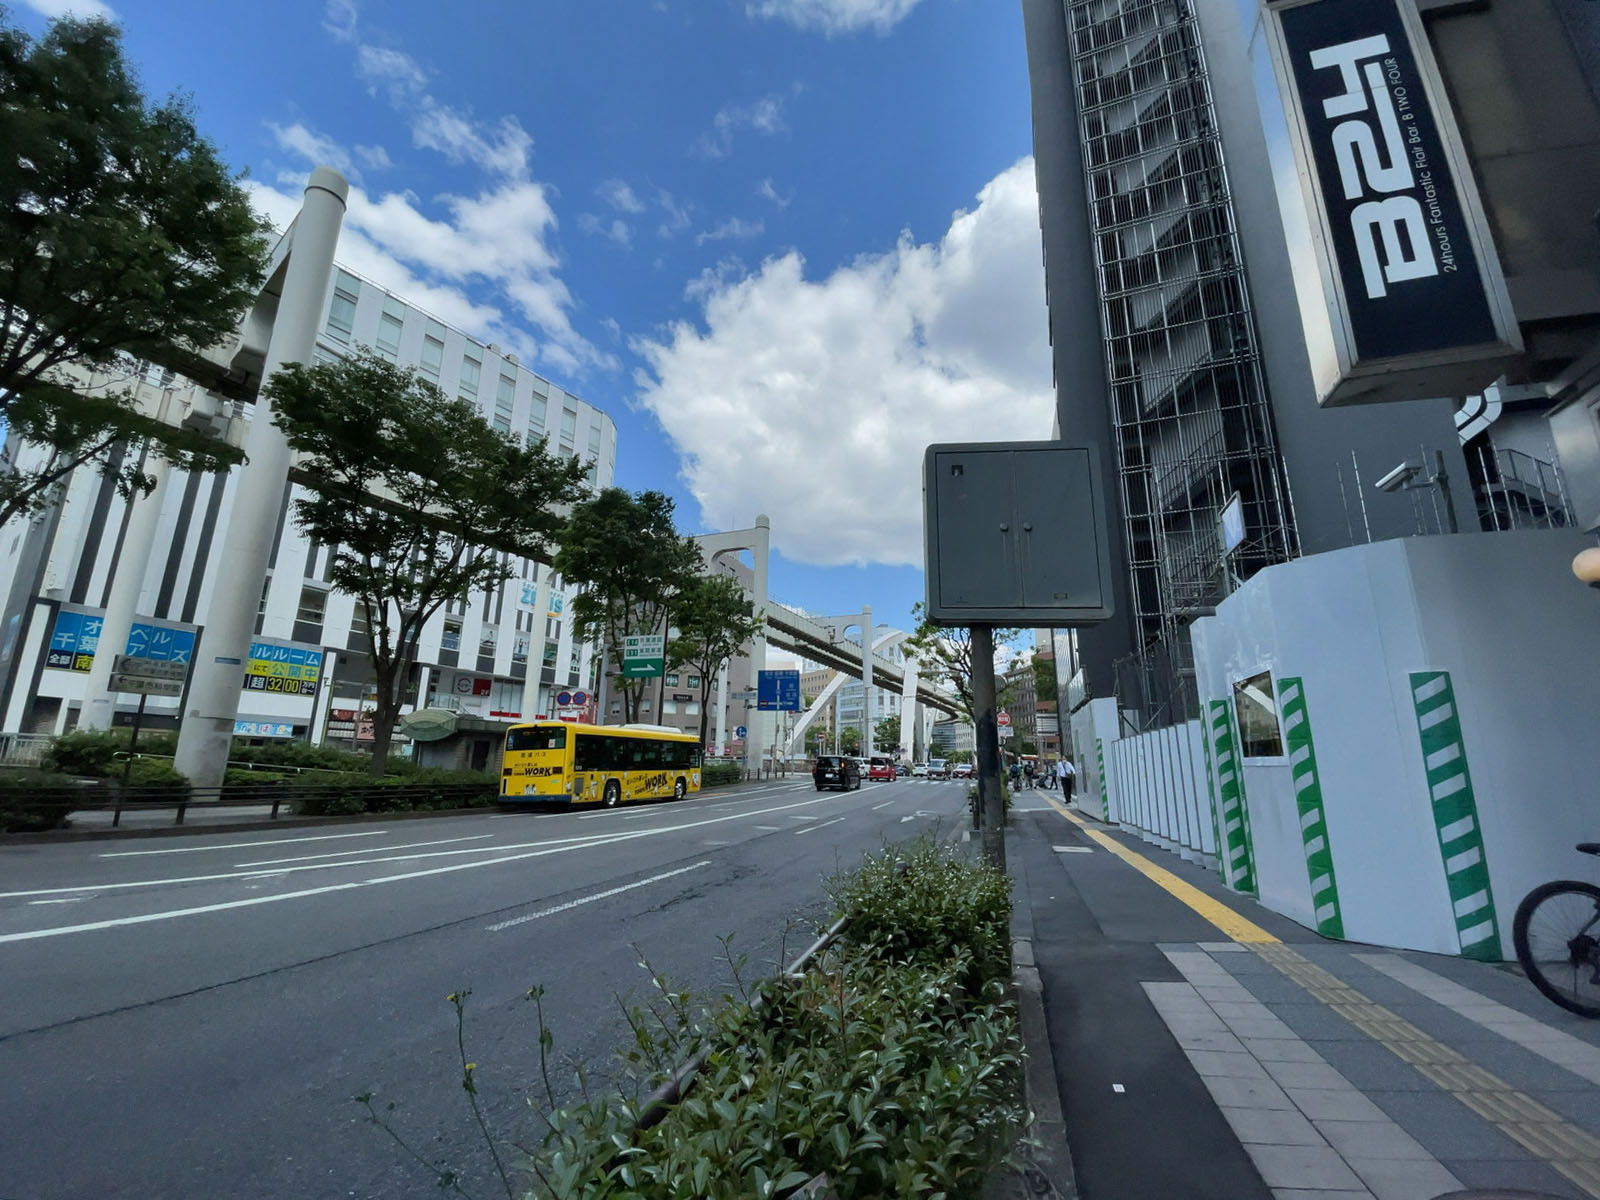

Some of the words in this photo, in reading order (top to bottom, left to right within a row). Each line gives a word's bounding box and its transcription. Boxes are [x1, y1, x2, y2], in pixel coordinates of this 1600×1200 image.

[1384, 57, 1403, 85] FOUR
[1393, 87, 1410, 111] TWO
[1402, 112, 1414, 121] B
[1308, 33, 1439, 299] B24
[1411, 146, 1428, 169] Flair
[1419, 170, 1442, 225] Fantastic
[1435, 226, 1457, 273] 24hours
[249, 643, 318, 666] ルルーム
